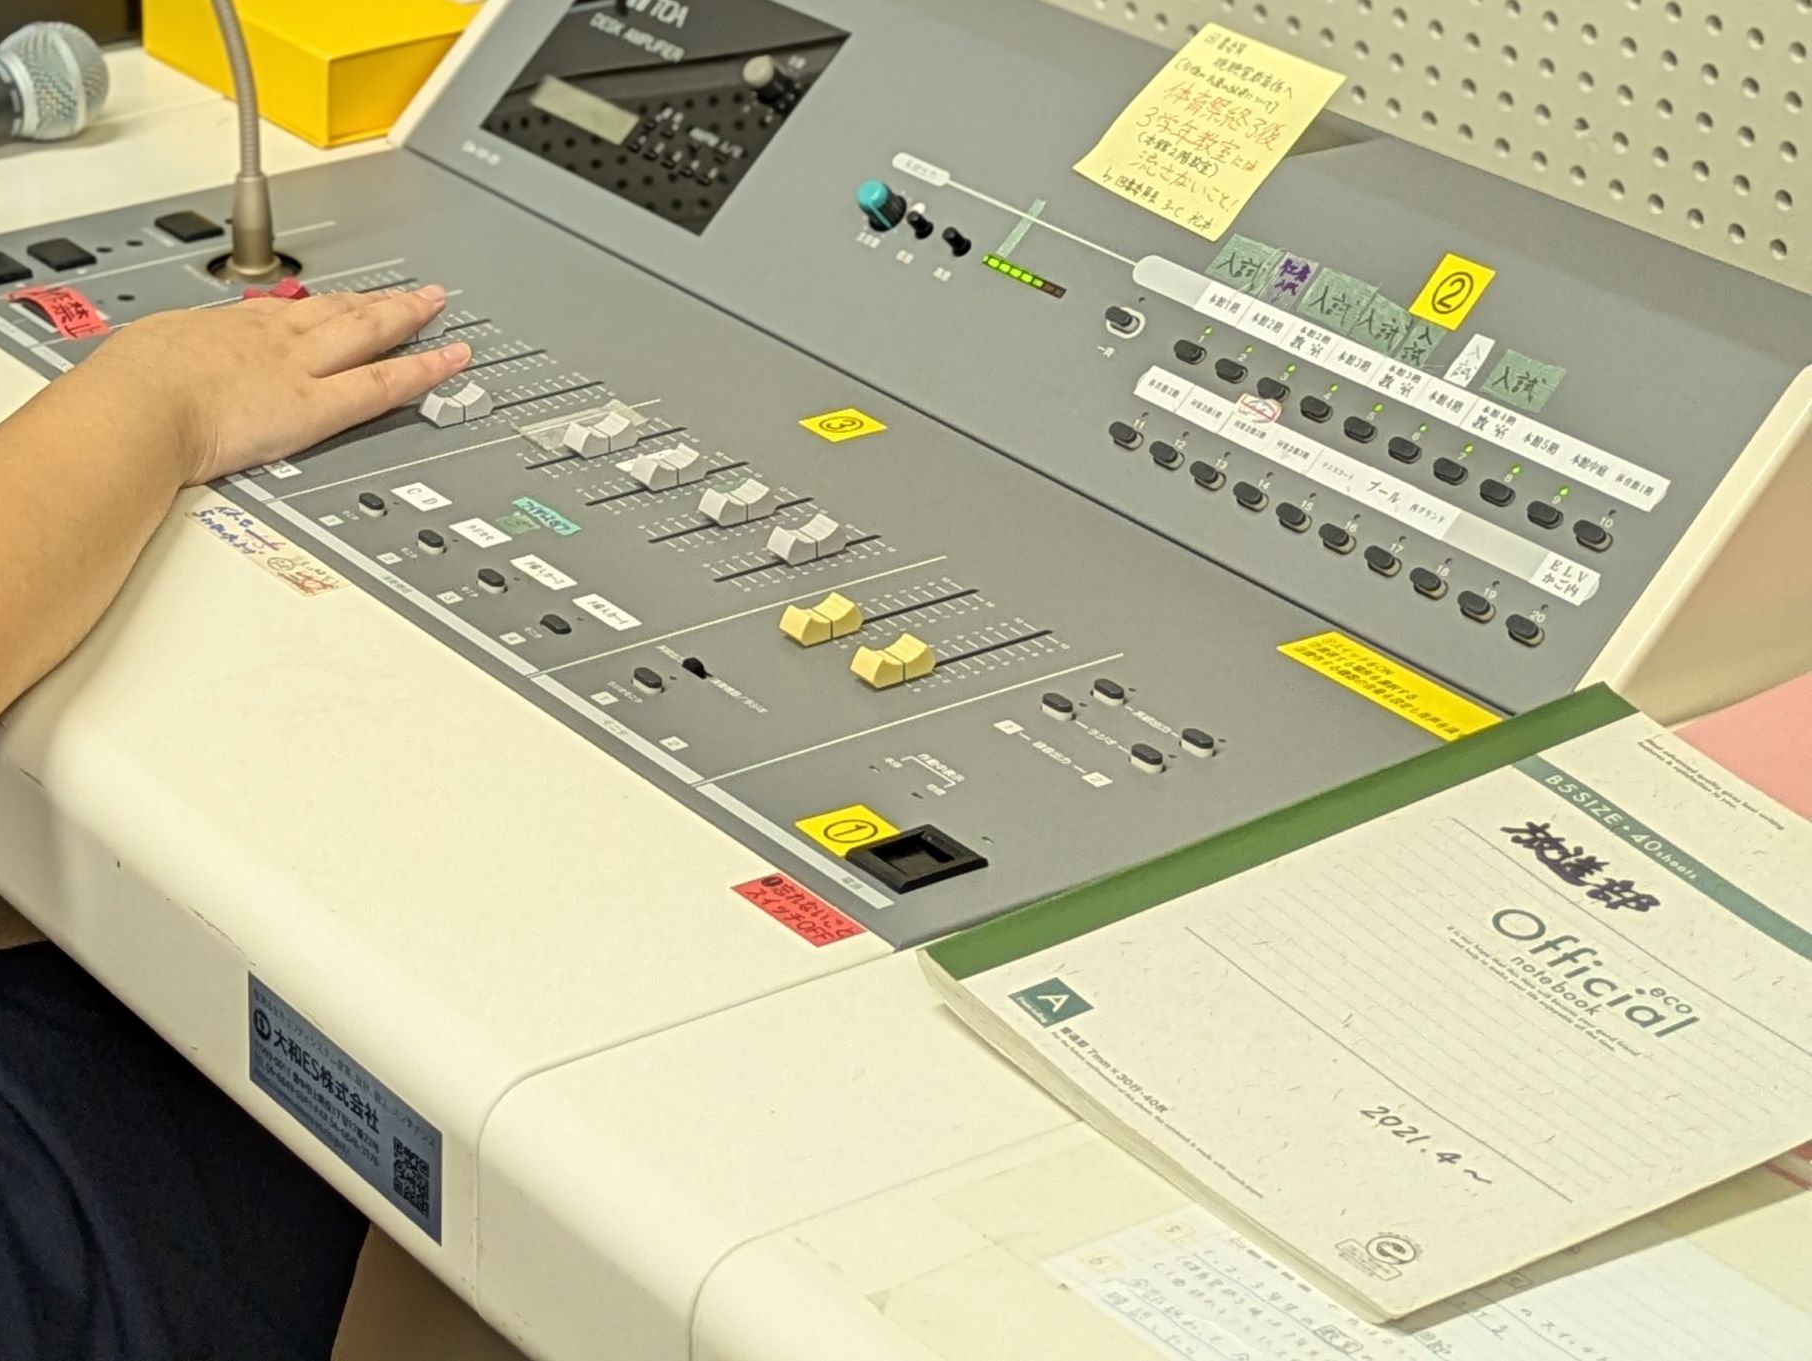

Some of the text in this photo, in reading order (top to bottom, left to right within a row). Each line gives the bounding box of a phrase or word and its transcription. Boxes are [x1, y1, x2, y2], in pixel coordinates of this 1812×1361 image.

[1251, 313, 1284, 334] 本館2階
[1133, 419, 1145, 429] 11
[1173, 439, 1187, 449] 12
[1522, 432, 1561, 456] 本館5階
[1215, 459, 1228, 470] 13
[1258, 479, 1271, 490] 14
[1367, 480, 1401, 504] プール
[1301, 500, 1314, 512] 15
[1345, 521, 1359, 533] 16
[1390, 543, 1405, 554] 17
[1437, 565, 1450, 577] 18
[1484, 588, 1498, 600] 19
[1530, 610, 1545, 623] 20
[1500, 821, 1661, 913] 放送部
[1491, 908, 1700, 1038] Official
[1510, 956, 1604, 1016] notebook
[1036, 993, 1070, 1013] A
[1649, 987, 1693, 1014] eco
[273, 1028, 381, 1135] 大和ES株式会社
